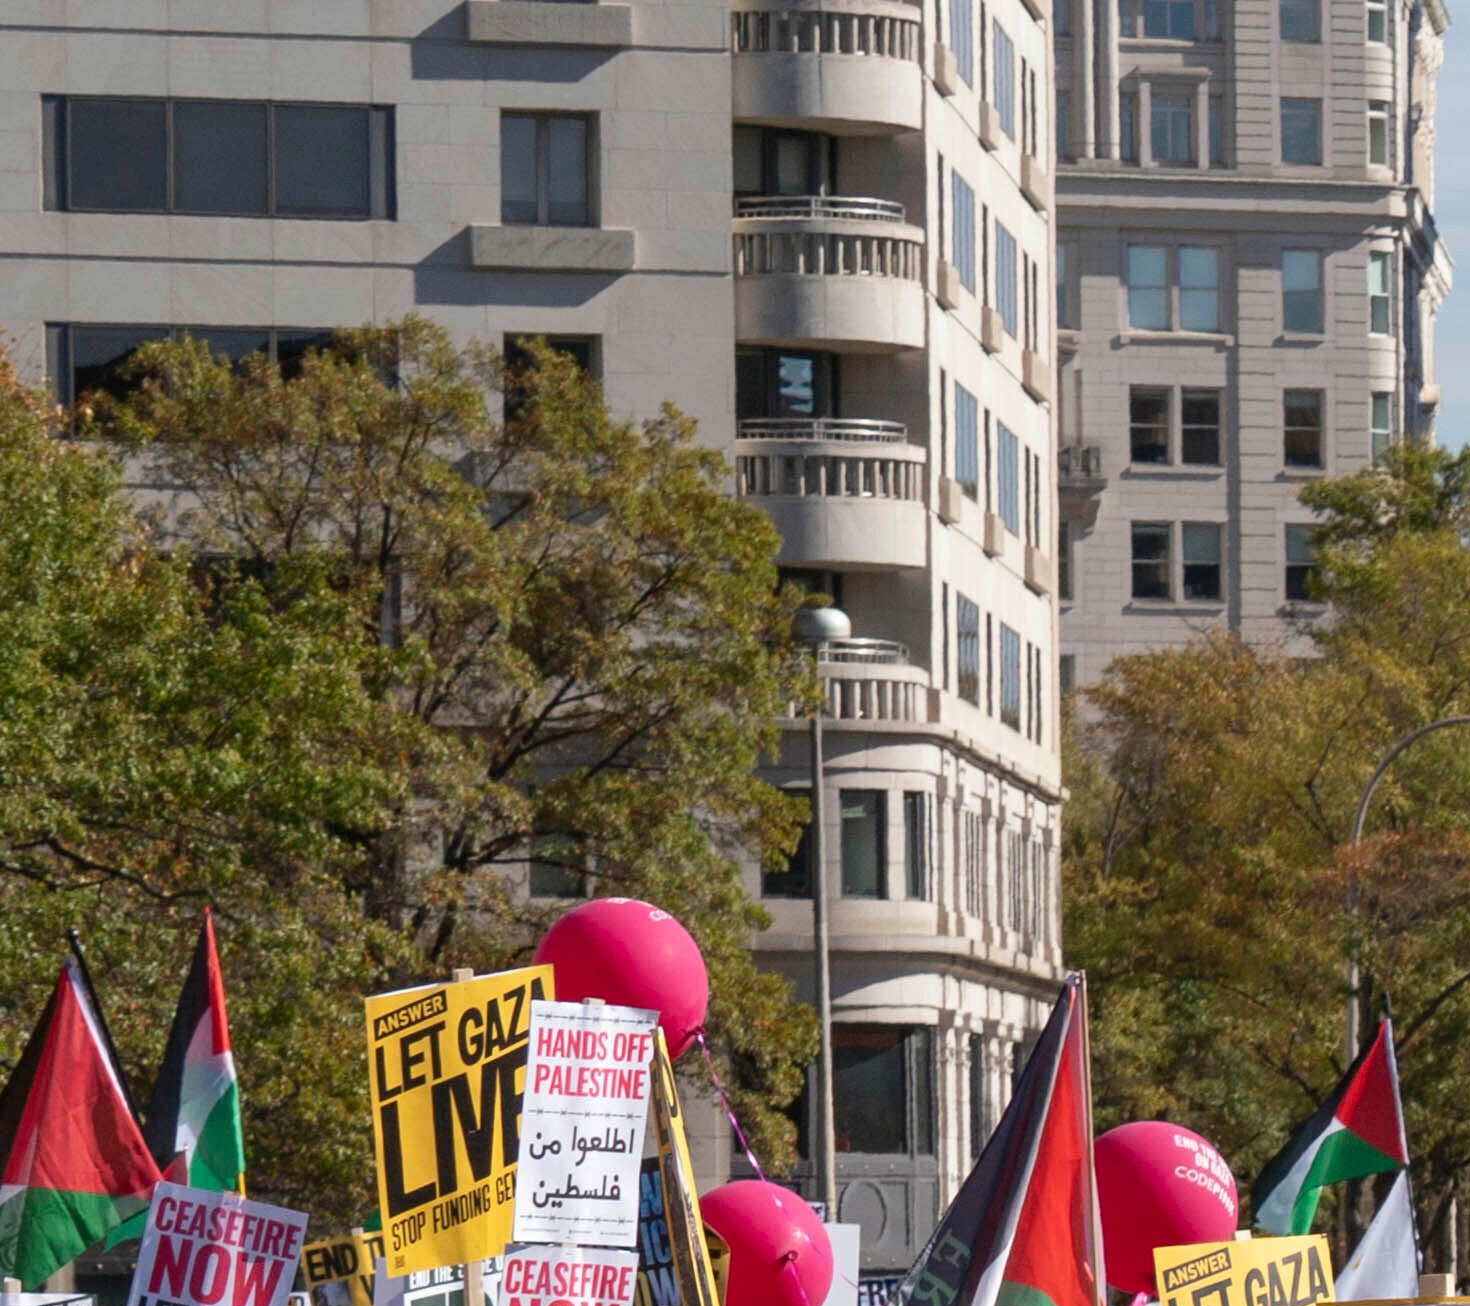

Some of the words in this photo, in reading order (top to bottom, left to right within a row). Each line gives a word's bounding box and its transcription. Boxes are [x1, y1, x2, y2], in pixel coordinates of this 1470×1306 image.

[378, 1019, 447, 1103] LET
[537, 1028, 608, 1061] HANDS
[613, 1034, 652, 1063] OFF
[534, 1064, 646, 1100] PALESTINE
[530, 1132, 561, 1159] من
[572, 1127, 635, 1166] اطلعوا
[533, 1174, 621, 1208] فلسطين
[1175, 1166, 1235, 1216] CODEPINK
[155, 1195, 298, 1261] CEASEFIRE
[505, 1259, 631, 1301] CEASEFIRE
